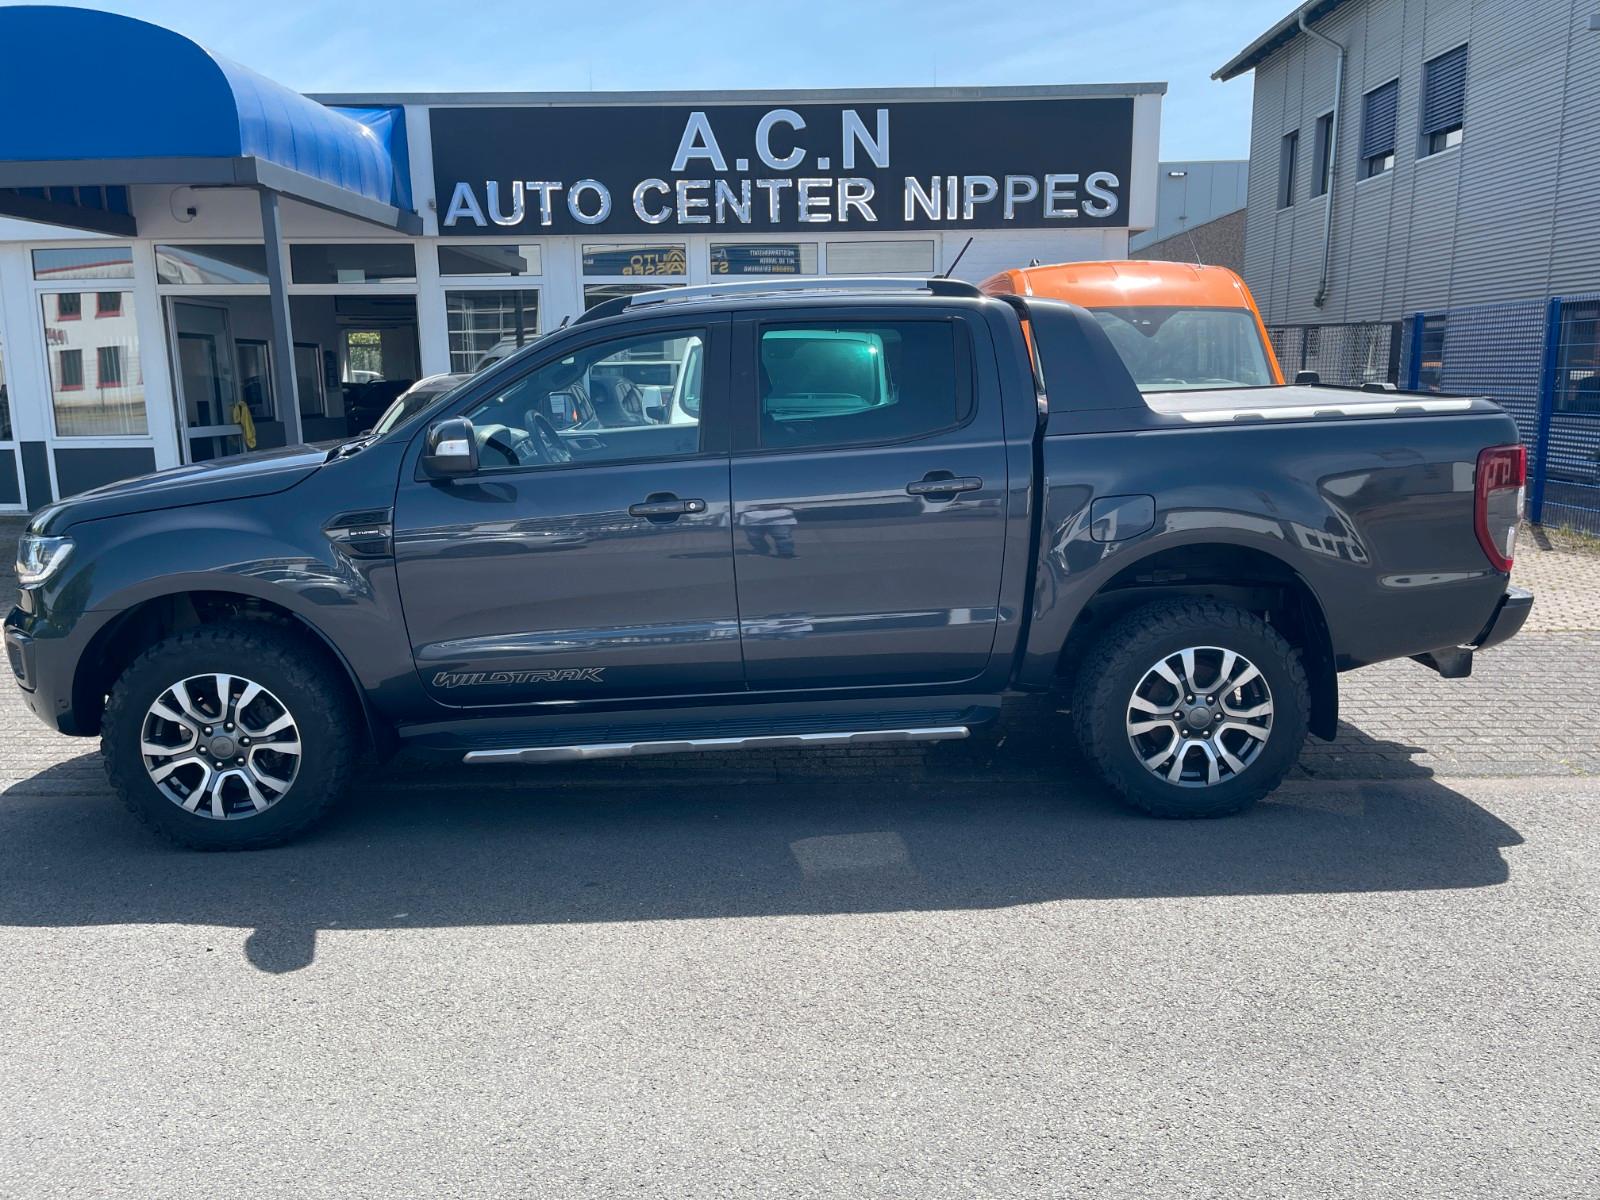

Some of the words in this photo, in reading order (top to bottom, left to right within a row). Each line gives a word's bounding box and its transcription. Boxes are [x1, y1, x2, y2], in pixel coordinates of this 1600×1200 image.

[671, 109, 890, 172] A.C.N
[443, 178, 612, 227] AUTO
[632, 177, 878, 225] CENTER
[904, 171, 1120, 221] NIPPES
[431, 667, 607, 689] WILDTRAK
